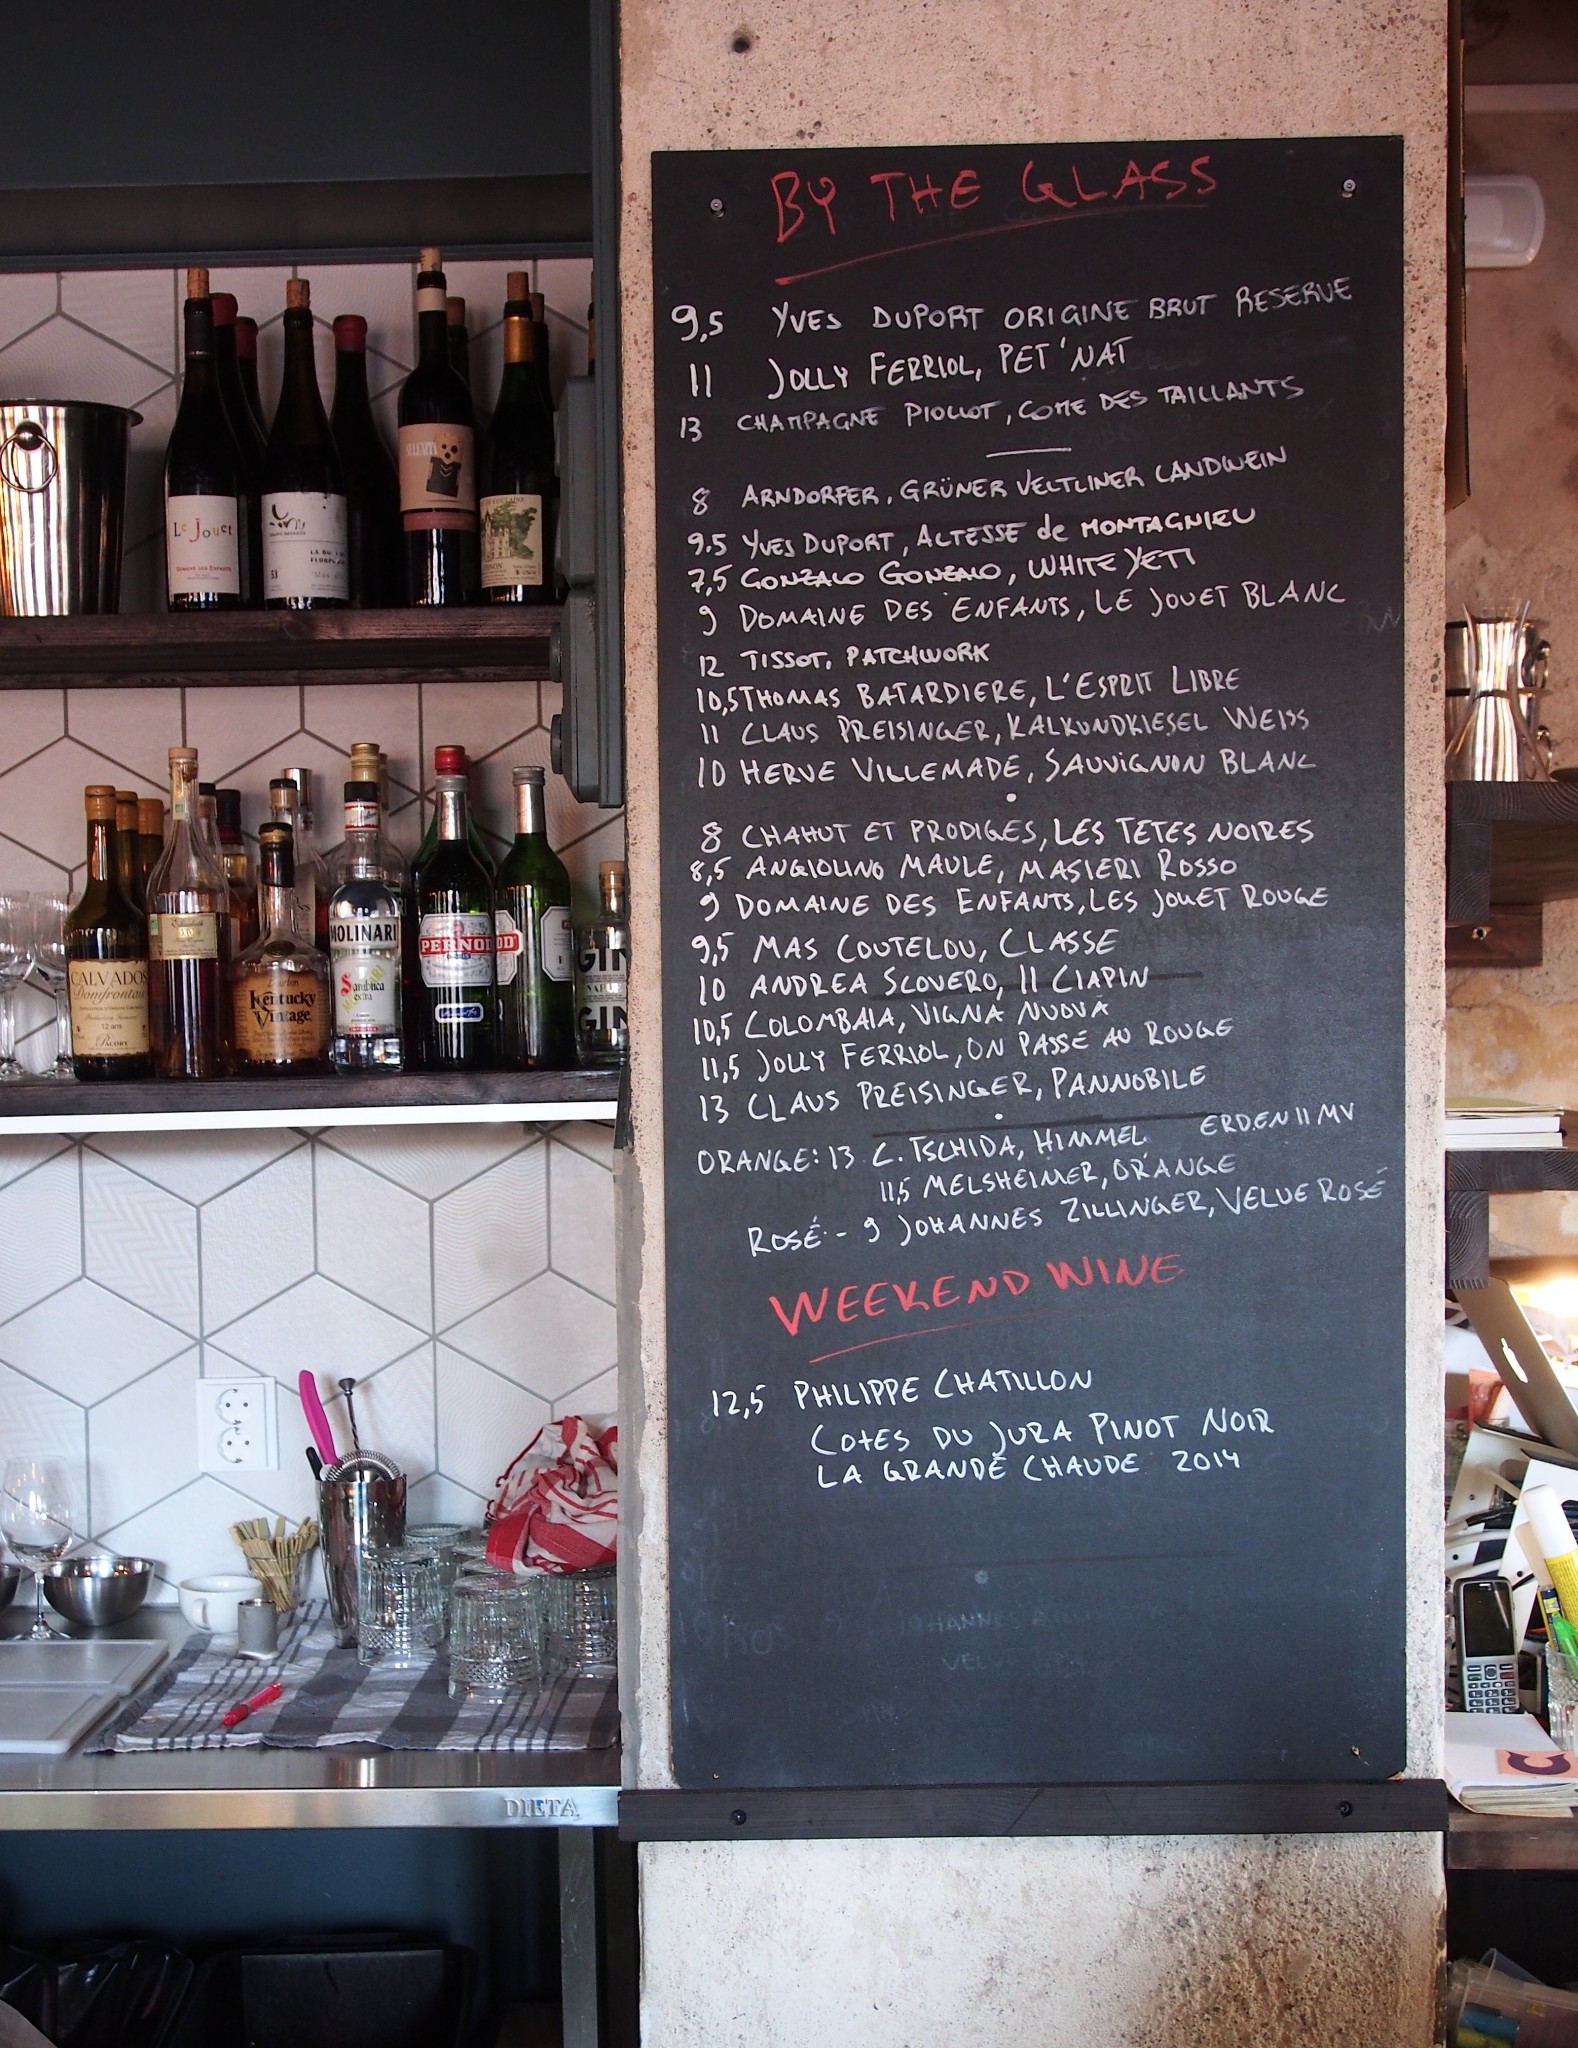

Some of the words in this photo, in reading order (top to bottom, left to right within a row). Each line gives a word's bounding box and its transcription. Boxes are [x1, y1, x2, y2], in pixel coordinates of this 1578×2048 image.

[771, 171, 836, 243] BY
[870, 170, 981, 221] THE
[1022, 156, 1216, 208] GLASS
[672, 305, 723, 342] 9,5
[772, 302, 842, 337] YVES
[873, 304, 984, 330] DUPORT
[1004, 300, 1138, 329] ORIGINE
[1149, 294, 1216, 319] BRUT
[1236, 277, 1352, 317] RESERVE
[690, 363, 711, 398] 11
[768, 358, 848, 399] JOLLY
[680, 417, 702, 442] 13
[737, 407, 884, 432] CHAMPAGNE
[1099, 390, 1148, 411] DES
[1157, 376, 1304, 404] TAILLANTS
[692, 487, 710, 515] 8
[900, 477, 1007, 502] GRÜNER
[1017, 466, 1145, 495] VELTLINER
[1156, 446, 1287, 483] LANDWEIN
[174, 522, 187, 537] Le
[189, 518, 232, 543] Jouet
[742, 529, 795, 559] YVES
[917, 522, 1027, 547] ALTESSE
[1037, 513, 1069, 542] de
[1081, 508, 1255, 538] MONTAGNIEU
[688, 564, 733, 596] 7,5
[741, 568, 864, 590] GONZALO
[1028, 553, 1117, 579] WHITE
[1124, 546, 1196, 579] YETI
[699, 605, 717, 636] 9
[739, 604, 865, 632] DOMAINE
[884, 599, 932, 621] DES
[1096, 589, 1132, 614] LE
[1150, 585, 1229, 617] JOUET
[1241, 580, 1346, 609] BLANC
[700, 656, 724, 677] 12
[846, 642, 990, 667] PATCHWORK
[739, 686, 840, 712] THOMAS
[1046, 672, 1152, 701] L'ESPRIT
[1173, 665, 1239, 694] LIBRE
[701, 723, 719, 744] 11
[742, 722, 819, 745] CLAUS
[1223, 706, 1309, 731] WEISS
[699, 757, 725, 788] 10
[1046, 748, 1205, 782] SAUVIGNON
[1219, 748, 1316, 774] BLANC
[701, 822, 723, 853] 8
[742, 824, 851, 848] CHAHUT
[864, 822, 895, 841] ET
[1054, 818, 1104, 846] LES
[1115, 817, 1197, 845] TETES
[1208, 819, 1314, 843] NOIRES
[690, 856, 731, 886] 8,5
[1019, 857, 1141, 883] MASIERI
[1157, 848, 1237, 881] ROSSO
[700, 892, 719, 922] 9
[735, 894, 869, 919] DOMAINE
[886, 894, 936, 917] DES
[1090, 888, 1138, 913] LES
[1152, 887, 1230, 918] JOUET
[1241, 884, 1328, 909] ROUGE
[692, 932, 734, 967] 9,5
[753, 935, 817, 963] MAS
[1000, 928, 1119, 958] CLASSE
[248, 989, 317, 1013] Kentucky
[700, 976, 725, 1006] 10
[750, 972, 867, 999] ANDREA
[1052, 964, 1148, 997] CIAPIN
[911, 1002, 1004, 1025] VIGNA
[757, 1049, 825, 1082] JOLLY
[968, 1037, 1004, 1060] ON
[1103, 1027, 1131, 1048] AU
[1144, 1018, 1233, 1045] ROUGE
[700, 1095, 729, 1124] 13
[748, 1090, 839, 1122] CLAUS
[1052, 1065, 1206, 1099] PANNOBILE
[829, 1146, 854, 1170] 13
[1318, 1103, 1354, 1125] MV
[864, 1217, 880, 1242] 9
[898, 1207, 1042, 1246] JOHANNES
[769, 1270, 1029, 1337] WEEKEND
[1047, 1255, 1184, 1289] WINE
[712, 1384, 767, 1421] 12,5
[795, 1377, 920, 1411] PHILIPPE
[934, 1367, 1093, 1401] CHATILLON
[933, 1427, 973, 1450] DU
[991, 1419, 1074, 1459] JURA
[1088, 1412, 1179, 1445] PINOT
[1202, 1407, 1274, 1436] NOIR
[818, 1465, 862, 1488] LA
[884, 1455, 1007, 1482] GRANDE
[1023, 1453, 1139, 1481] CHAUDE
[1172, 1449, 1240, 1472] 2014
[503, 1797, 580, 1818] DIETA
